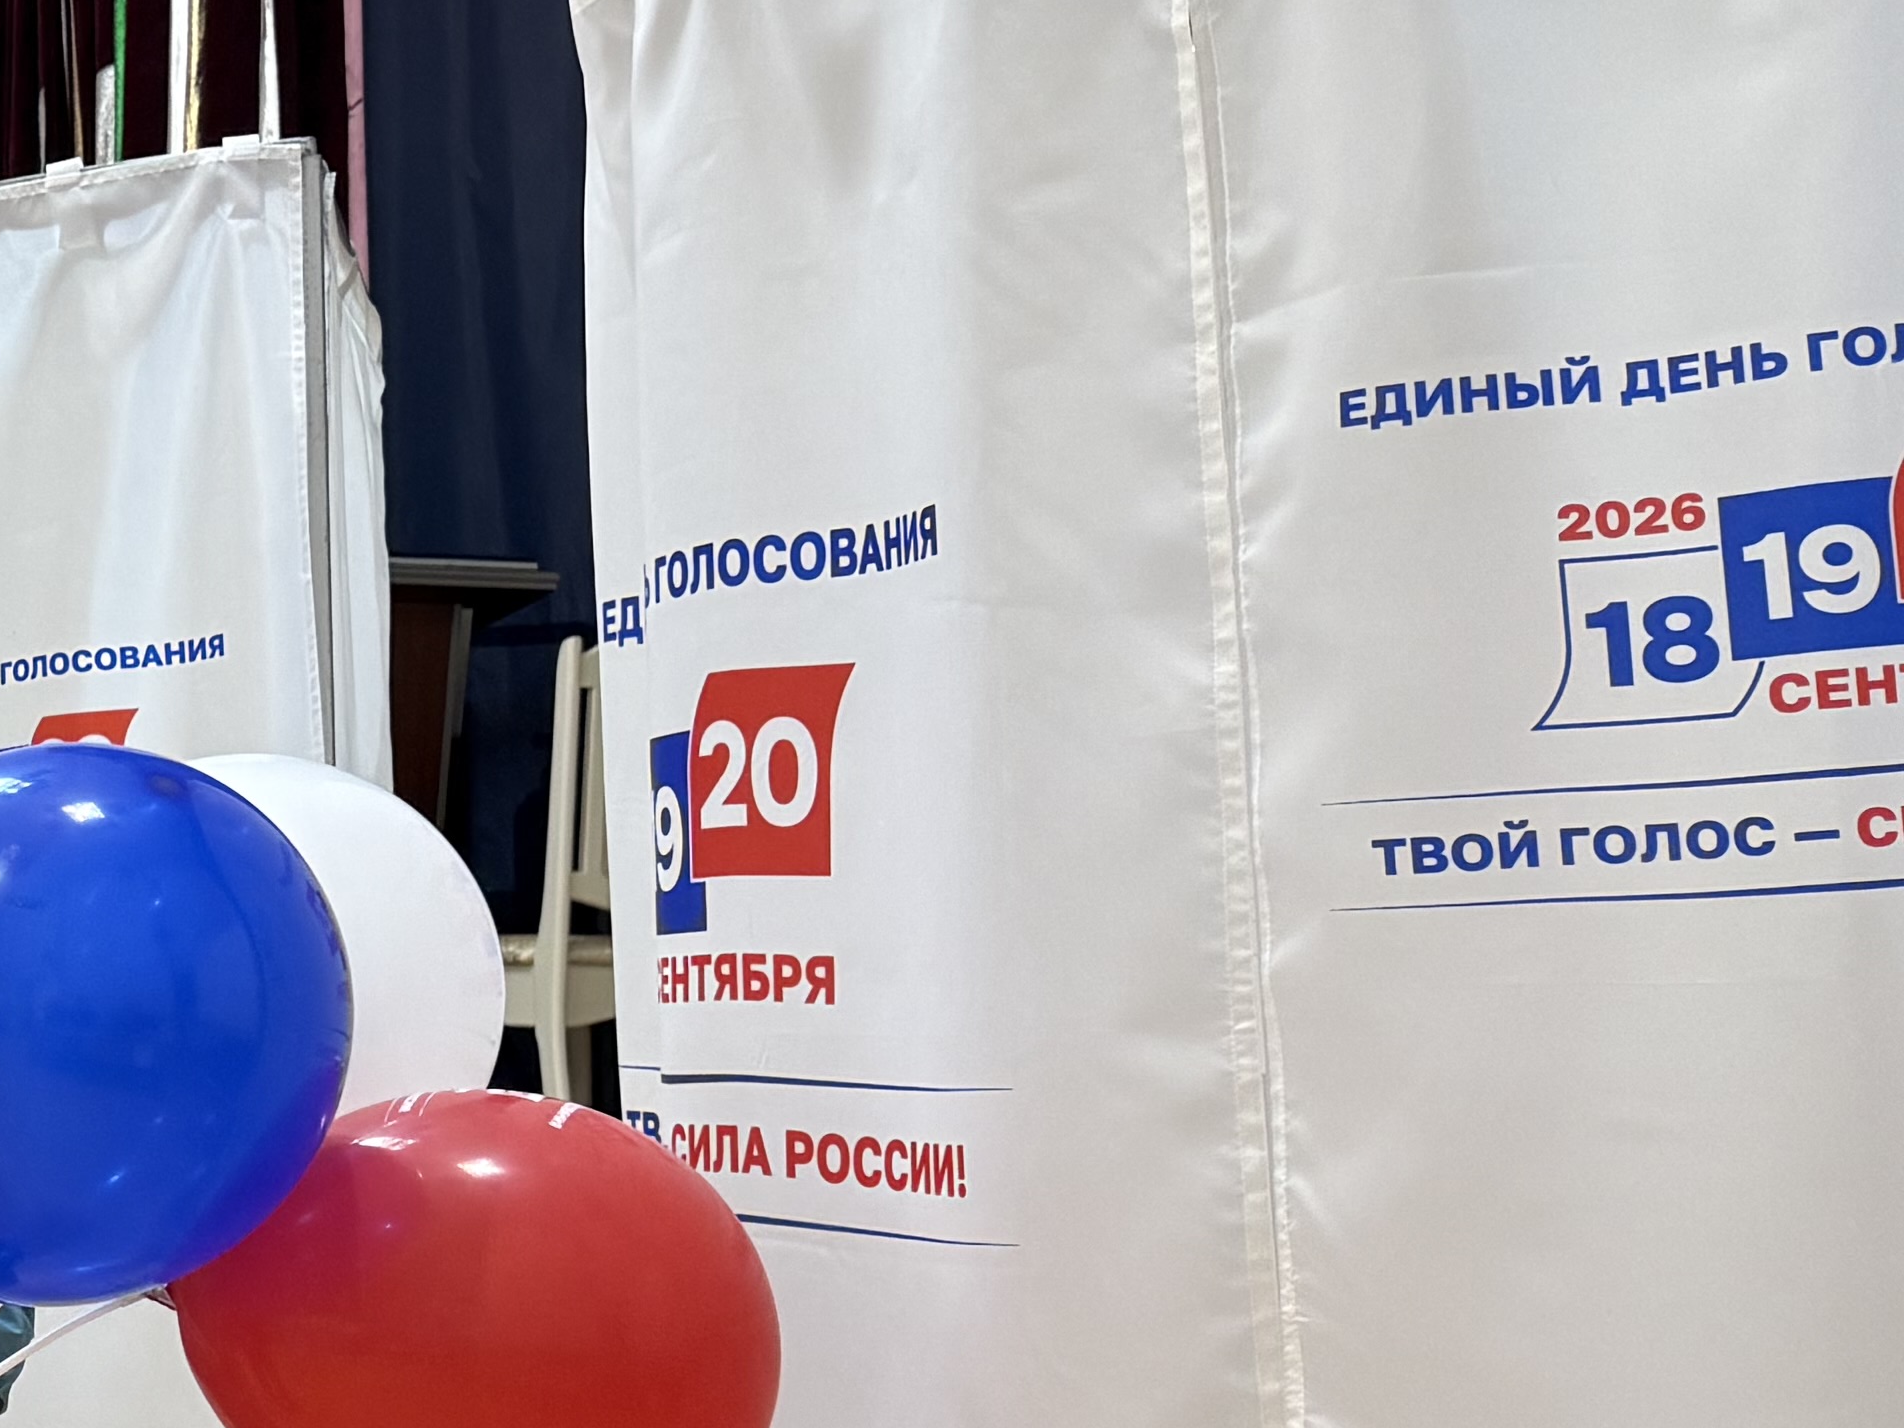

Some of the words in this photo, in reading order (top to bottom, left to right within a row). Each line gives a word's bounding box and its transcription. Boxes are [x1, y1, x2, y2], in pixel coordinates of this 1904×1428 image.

[1339, 355, 1602, 430] ЕДИНЫЙ
[1620, 341, 1788, 406] ДЕНЬ
[1557, 492, 1707, 542] 2026
[603, 595, 644, 647] ЕД
[654, 504, 938, 604] ГОЛОСОВАНИЯ
[1585, 594, 1721, 688] 18
[1742, 523, 1881, 621] 19
[0, 634, 226, 685] ГОЛОСОВАНИЯ
[1768, 664, 1904, 714] СЕН
[653, 786, 683, 892] 9
[699, 716, 818, 830] 20
[1371, 819, 1540, 876] ТВОЙ
[1559, 816, 1776, 866] ГОЛОС
[658, 953, 836, 1005] ЕНТЯБРЯ
[672, 1123, 772, 1177] СИЛА
[786, 1129, 967, 1198] РОССИИ!
